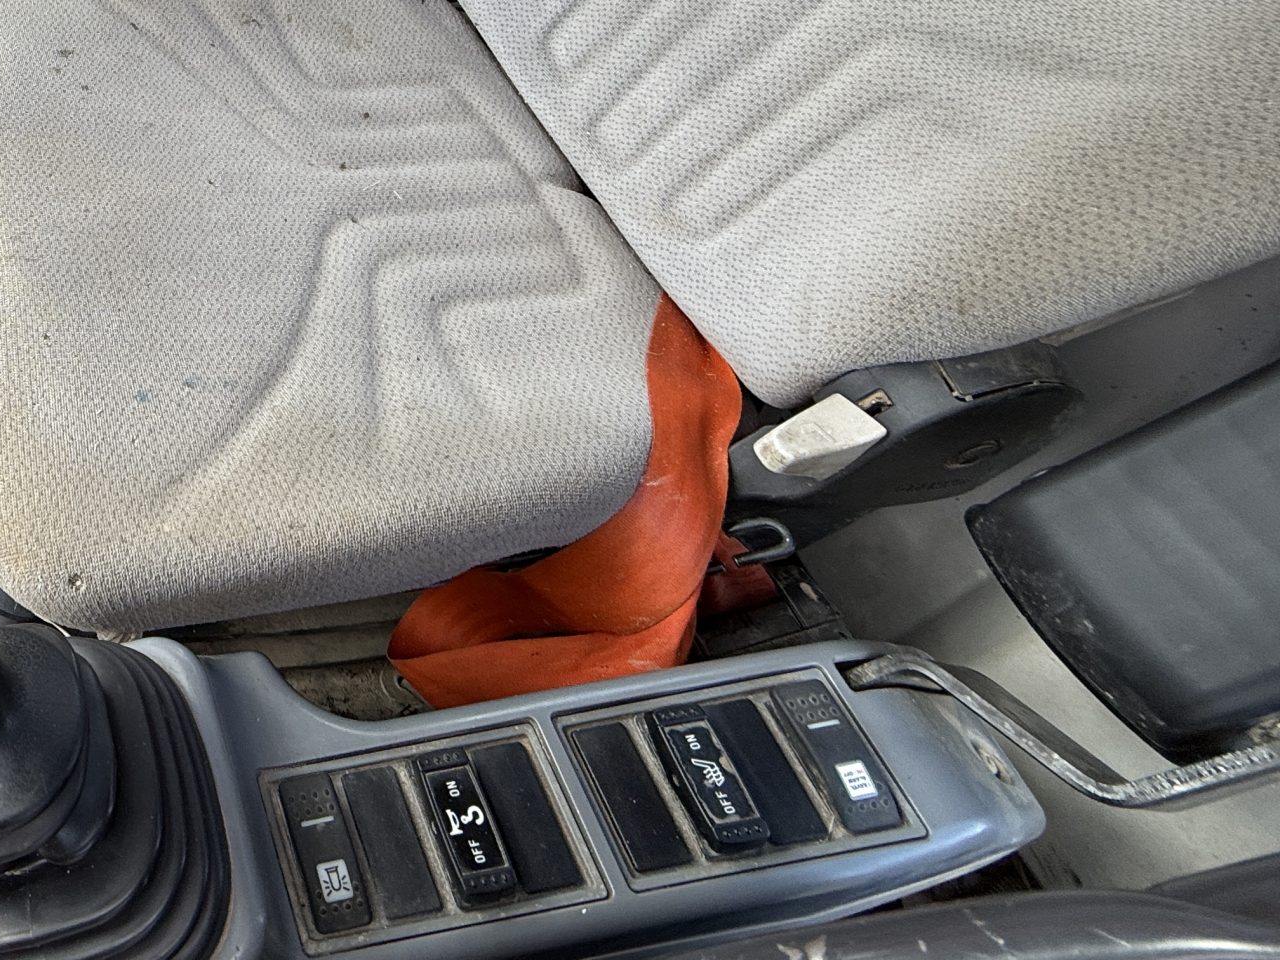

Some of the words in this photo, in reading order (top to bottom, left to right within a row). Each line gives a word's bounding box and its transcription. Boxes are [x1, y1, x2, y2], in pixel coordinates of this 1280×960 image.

[685, 734, 701, 750] ON
[446, 780, 460, 797] ON
[715, 791, 736, 814] OFF
[468, 840, 486, 863] OFF
